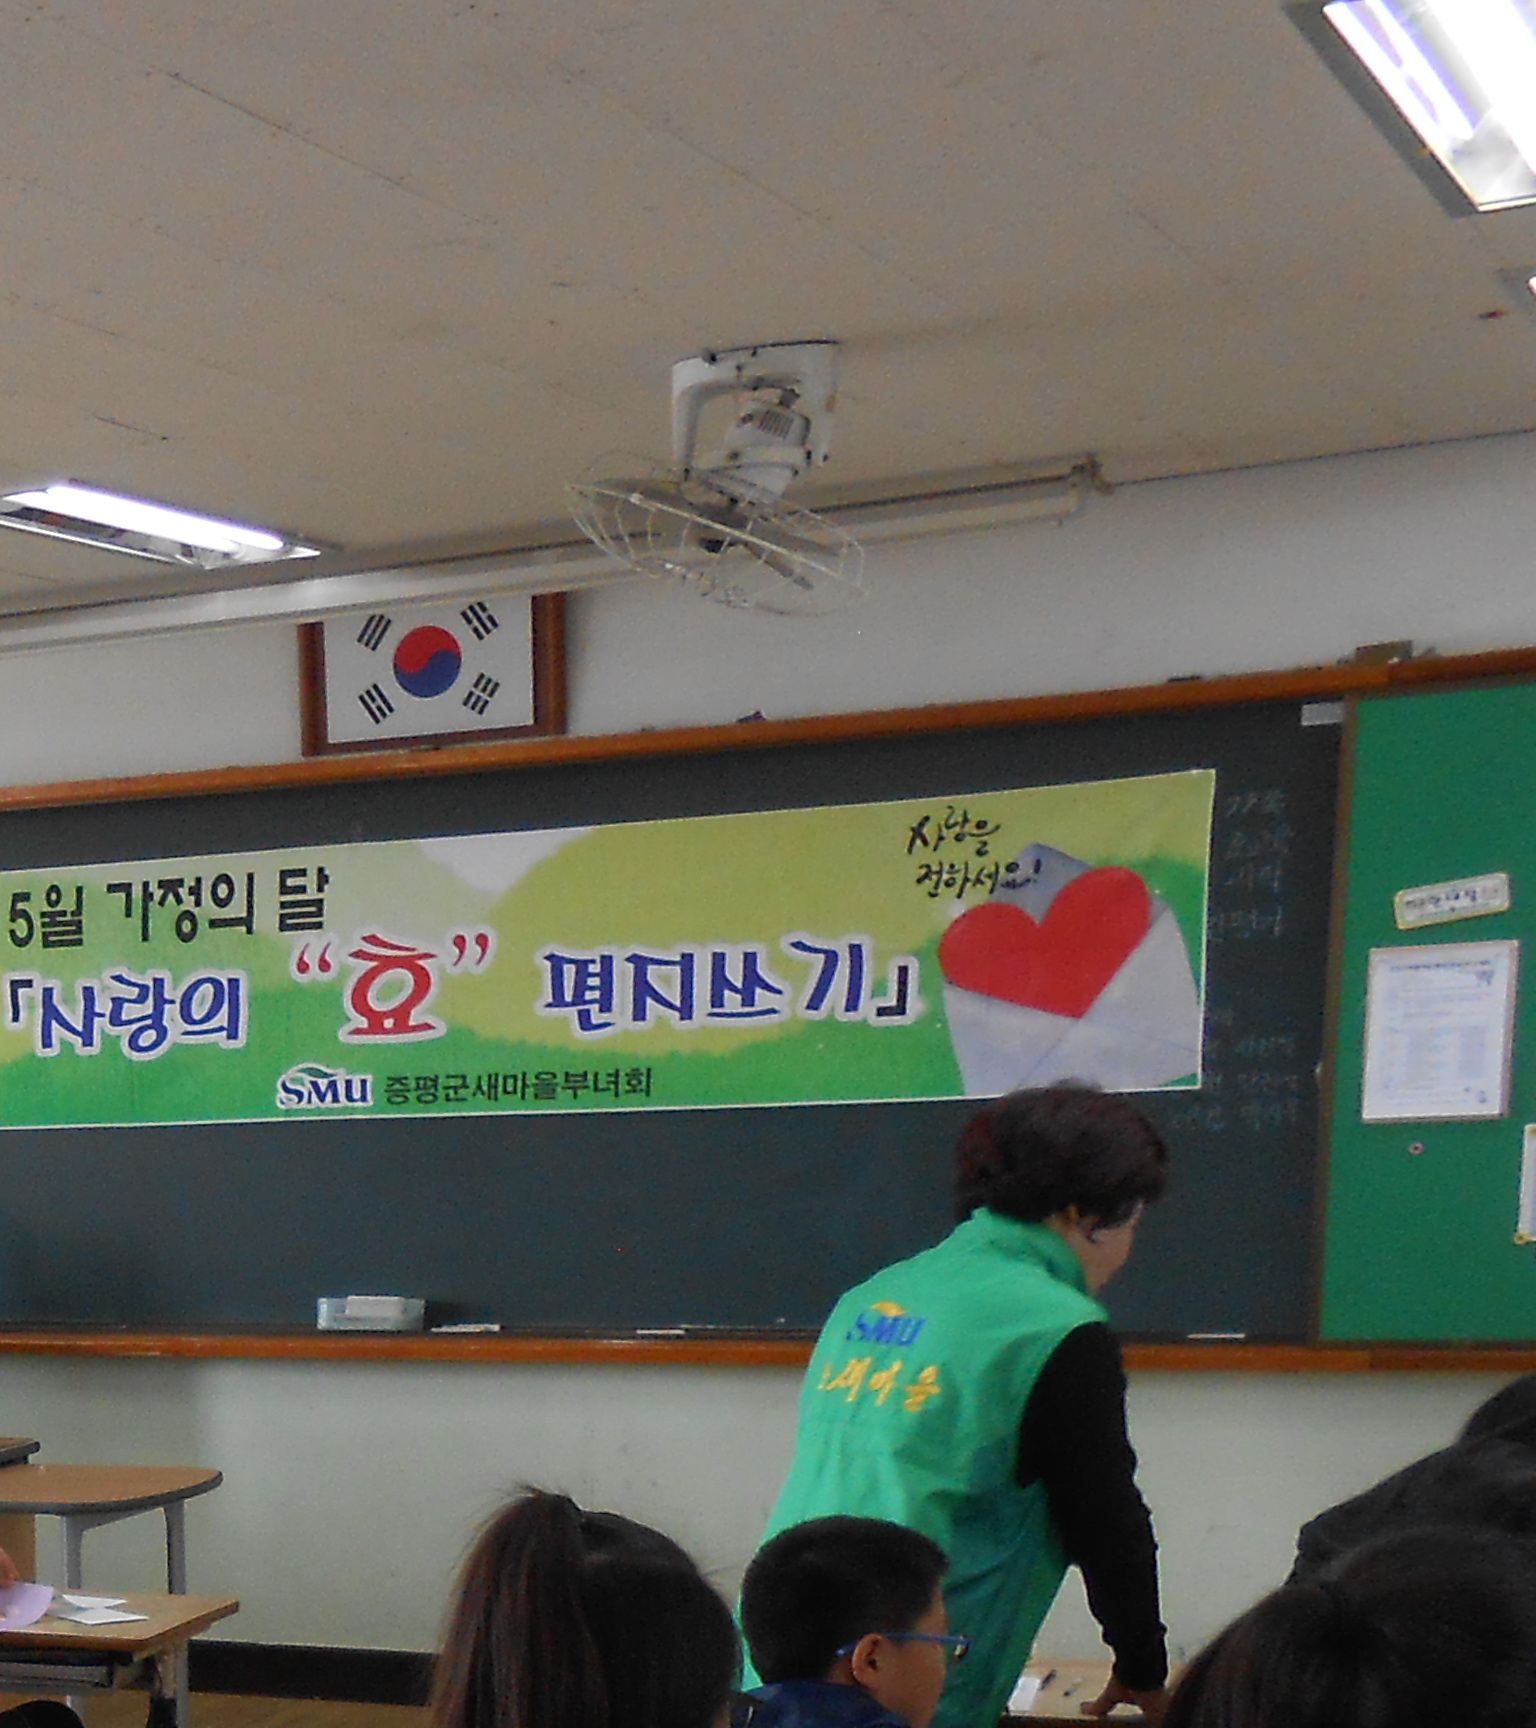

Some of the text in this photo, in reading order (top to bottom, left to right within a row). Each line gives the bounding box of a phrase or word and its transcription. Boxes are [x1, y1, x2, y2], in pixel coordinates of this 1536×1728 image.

[907, 805, 1001, 856] 사랑을
[8, 866, 331, 949] 5월 가정의 달
[384, 1067, 653, 1106] 증평군새마을부녀회
